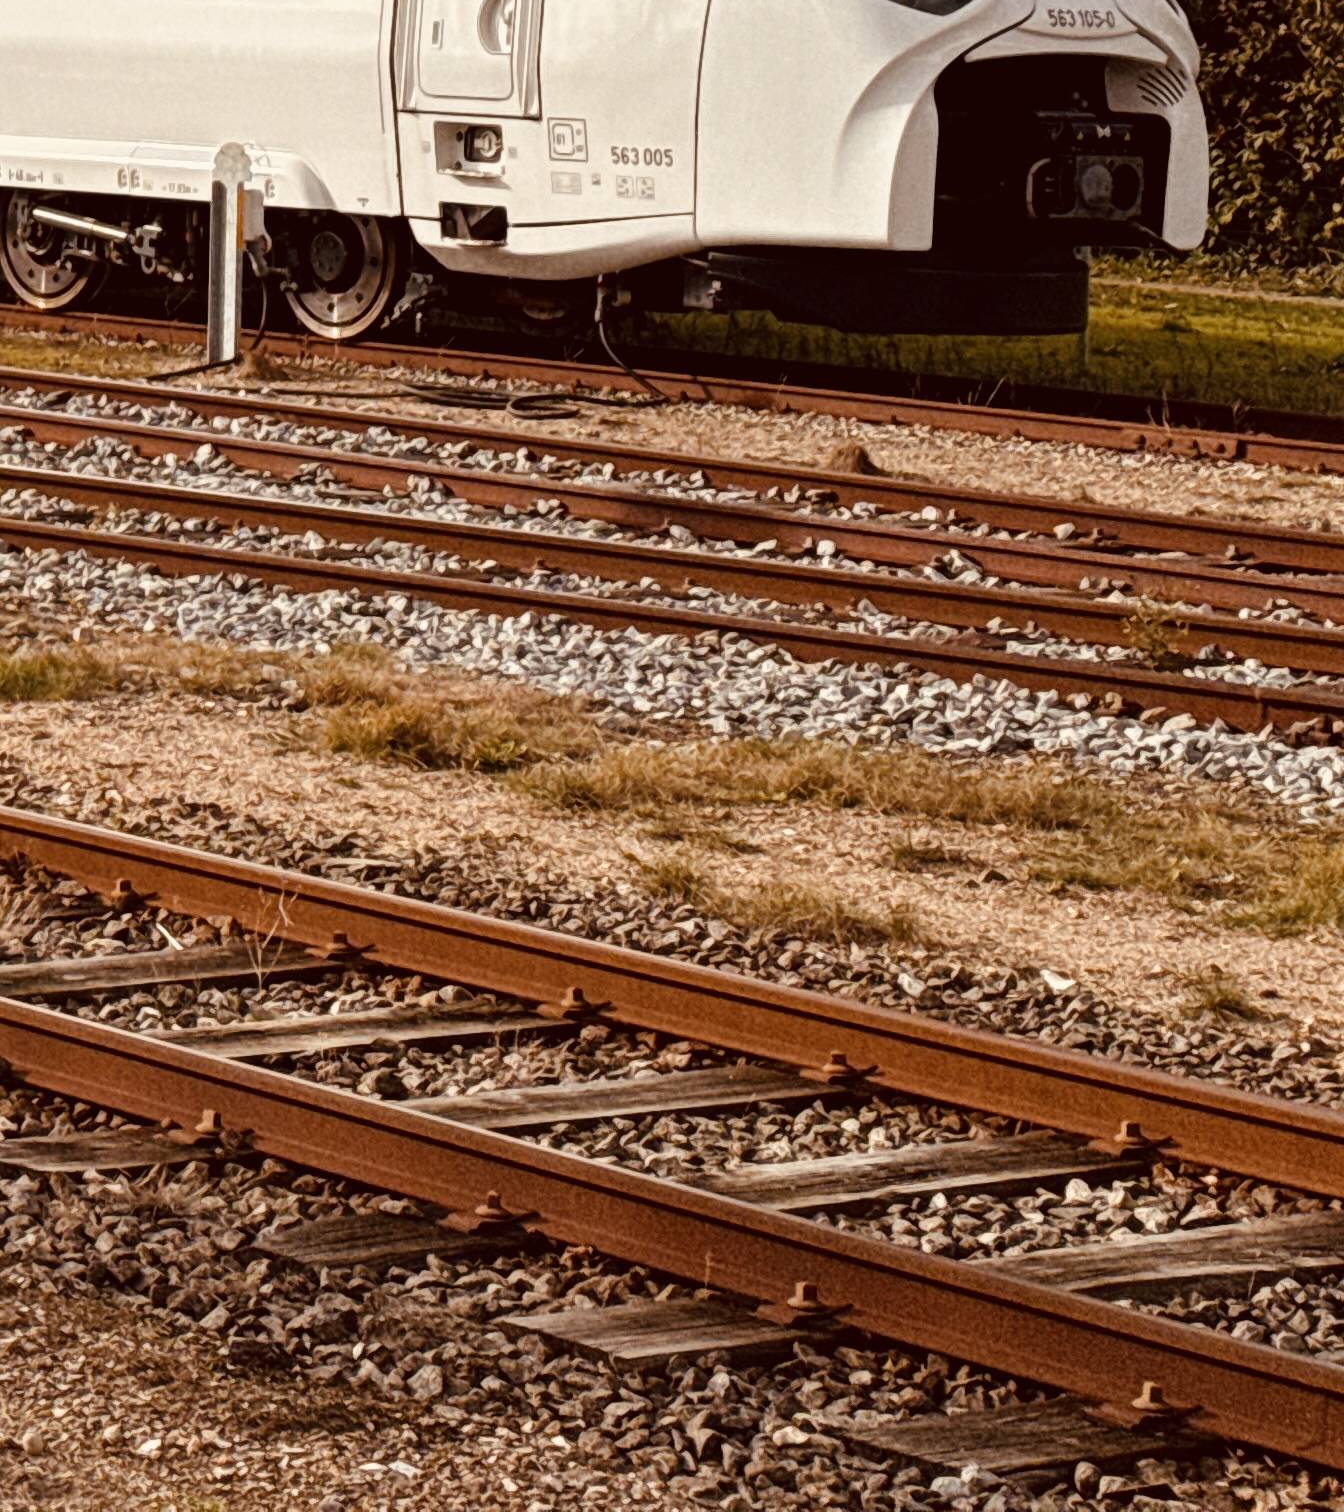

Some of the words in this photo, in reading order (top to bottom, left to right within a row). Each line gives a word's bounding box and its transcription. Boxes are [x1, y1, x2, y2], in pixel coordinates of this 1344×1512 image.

[1048, 9, 1076, 27] 563
[1078, 9, 1115, 28] 105-0
[611, 146, 640, 165] 563
[643, 148, 673, 167] 005
